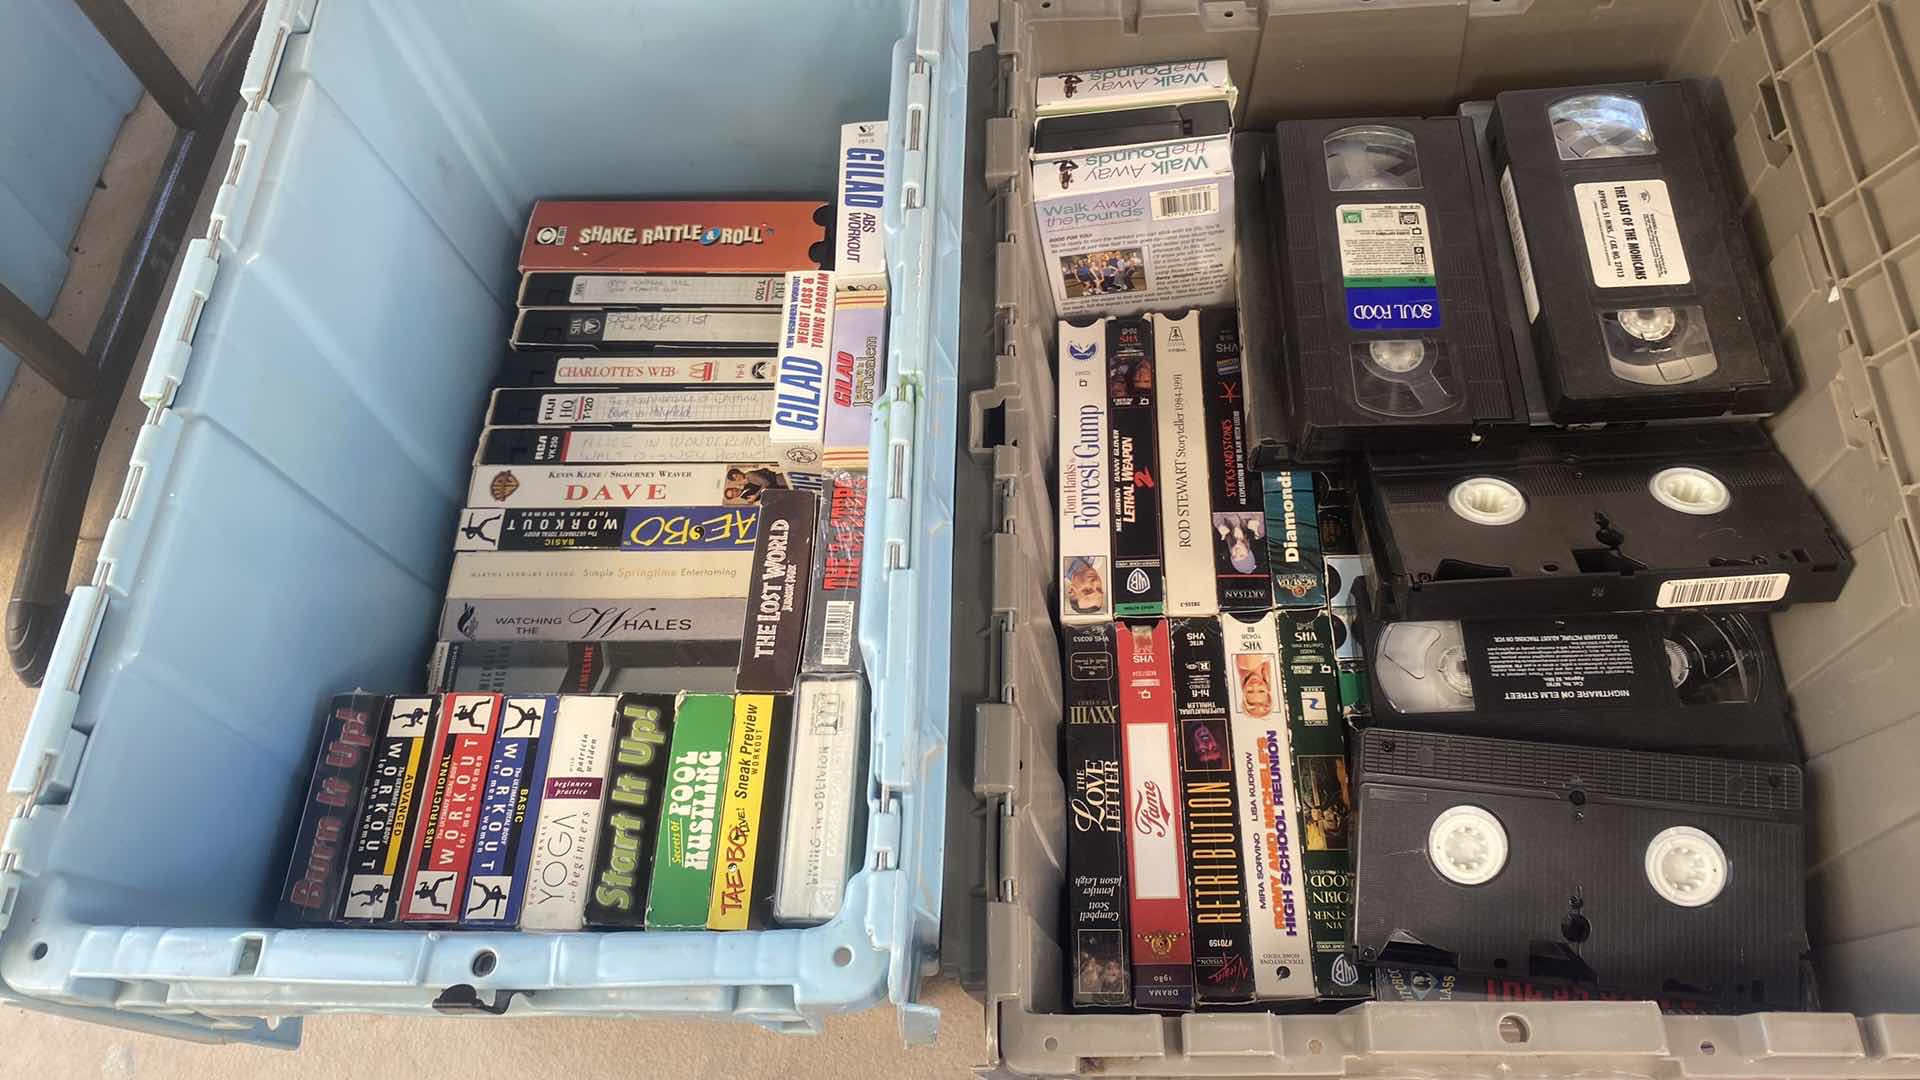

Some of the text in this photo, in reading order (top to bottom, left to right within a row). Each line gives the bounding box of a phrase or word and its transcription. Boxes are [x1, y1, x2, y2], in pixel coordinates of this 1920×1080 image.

[1087, 72, 1208, 93] Walk Away
[844, 148, 884, 208] GILAD
[1084, 155, 1209, 181] Walk Away
[862, 213, 875, 232] ABS
[1043, 197, 1144, 217] Walk Away
[641, 224, 702, 244] RATTLE
[720, 226, 762, 244] ROLL
[848, 212, 861, 262] WORKOUT
[1614, 186, 1648, 280] THE LAST OF THE MOHICANS
[803, 288, 813, 311] LOSS
[811, 273, 829, 349] TONING PROGRAM
[1353, 304, 1432, 320] SOUL FOOD
[797, 313, 811, 345] WEIGHT
[559, 366, 677, 377] CHARLOTTE'S WEB
[833, 351, 855, 408] GILAD
[852, 336, 877, 408] Jerusalem
[544, 398, 557, 420] FUJI
[559, 400, 574, 418] HQ
[583, 397, 594, 420] T-120
[776, 355, 822, 432] GILAD
[535, 435, 548, 460] RCA
[1073, 405, 1104, 458] Gump
[1112, 429, 1120, 457] GLOVER
[1221, 419, 1233, 449] STONES
[548, 470, 692, 479] KEVIN KLINE SIGOURNEY WEAVER
[1113, 458, 1121, 482] DANNY
[1222, 450, 1235, 468] AND
[564, 483, 668, 501] DAVE
[1063, 463, 1077, 516] Tom Hanks
[1120, 436, 1136, 523] LETHAL WEAPON
[1134, 465, 1154, 488] 2
[1173, 411, 1191, 548] ROD STEWART Storyteller
[1072, 462, 1101, 529] Forrest
[507, 519, 619, 530] WORKOUT
[544, 538, 575, 546] BASIC
[583, 567, 737, 578] Simple Springtime Entertaining
[753, 519, 790, 658] THE LOST WORLD
[786, 563, 797, 583] PARK
[823, 557, 864, 590] THE
[496, 617, 562, 625] WATCHING
[516, 627, 538, 635] THE
[568, 607, 692, 639] WHALES
[1186, 632, 1206, 640] VHS
[1294, 632, 1318, 641] VHS
[1133, 655, 1154, 663] VHS
[1242, 642, 1262, 650] VHS
[1187, 702, 1216, 710] THRILLER
[1192, 689, 1210, 698] hi-fi
[1504, 692, 1539, 700] STREET
[1561, 691, 1575, 699] ON
[1576, 690, 1630, 699] NIGHTMARE
[576, 733, 589, 772] patricia
[586, 739, 597, 772] walden
[734, 704, 758, 799] Sneak Preview
[751, 730, 763, 776] WORKOUT
[552, 780, 593, 789] beginners
[555, 788, 588, 797] practice
[668, 751, 699, 816] POOL
[1071, 759, 1106, 832] LOVE
[1076, 769, 1085, 791] THE
[1104, 760, 1121, 832] LETTER
[290, 707, 371, 908] Burn It Up!
[358, 759, 387, 853] for men women
[362, 742, 403, 870] WORKOUT
[393, 774, 414, 837] ADVANCED
[423, 755, 451, 848] INSTRUCTIONAL
[439, 739, 479, 864] WORKOUT
[456, 755, 483, 848] for men women
[477, 760, 501, 853] for men women
[482, 743, 518, 870] WORKOUT
[514, 789, 529, 824] BASIC
[596, 705, 667, 910] Start It Up!
[684, 751, 723, 870] HUSTLING
[671, 821, 681, 864] Secrets Of
[1245, 752, 1266, 910] MIRA SORVINO LISA KUDROW
[1266, 729, 1298, 937] HIGH SCHOOL REUNION
[537, 814, 578, 905] YOGA
[568, 810, 591, 887] beginners
[1187, 782, 1242, 923] RETRIBUTION
[1075, 876, 1122, 886] Jason Leigh
[1083, 886, 1114, 896] Jennifer
[1266, 832, 1286, 929] ROMY AND
[1080, 911, 1119, 921] Campbell
[1089, 902, 1110, 910] Scott
